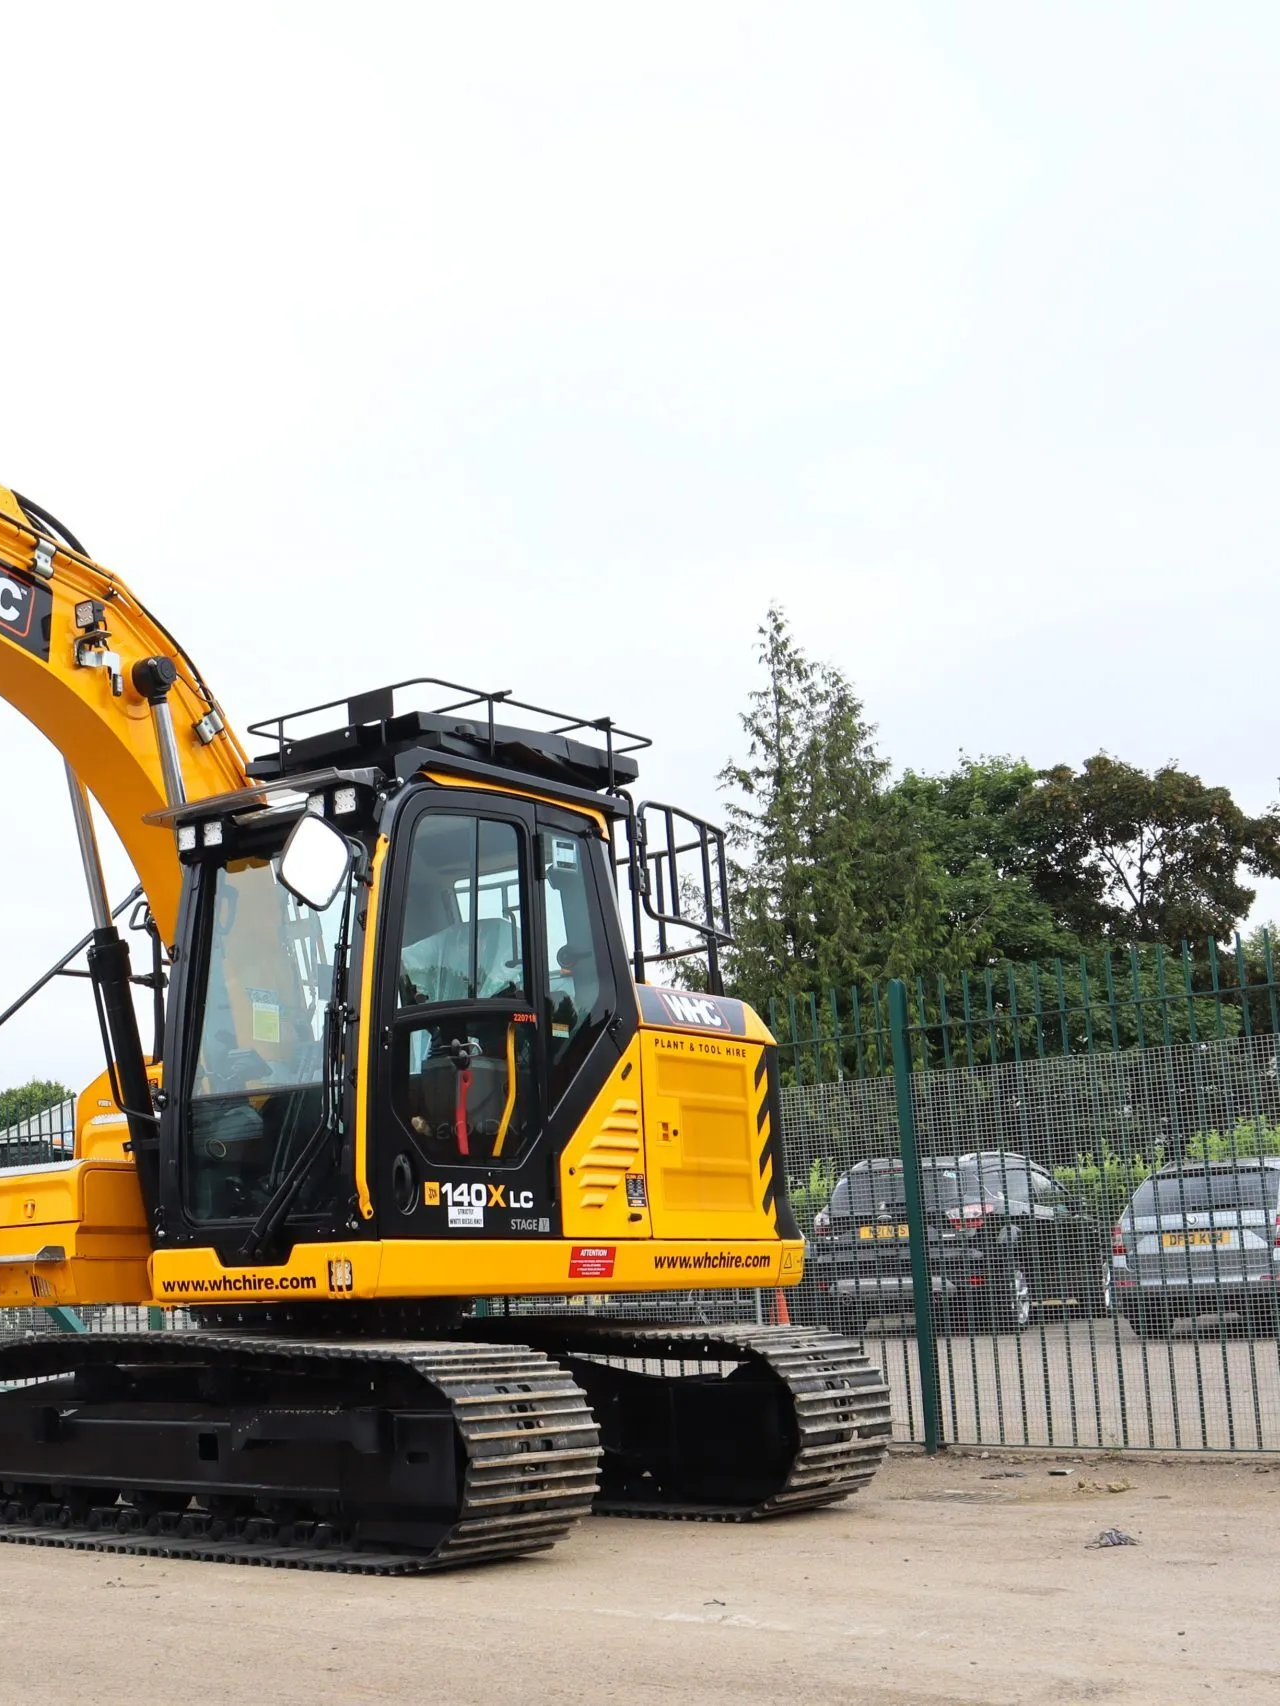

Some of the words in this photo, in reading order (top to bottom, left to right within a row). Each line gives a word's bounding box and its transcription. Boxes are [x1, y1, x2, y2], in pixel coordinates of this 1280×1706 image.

[661, 993, 722, 1026] WHC
[654, 1038, 685, 1050] PLANT
[689, 1043, 695, 1052] &
[699, 1043, 722, 1055] TOOL
[726, 1047, 747, 1058] HIRE
[509, 1190, 534, 1208] LC
[510, 1218, 538, 1231] STAGE
[580, 1249, 608, 1257] ATTENTION
[654, 1251, 771, 1269] www.whchire.com
[162, 1274, 317, 1293] www.whchire.com
